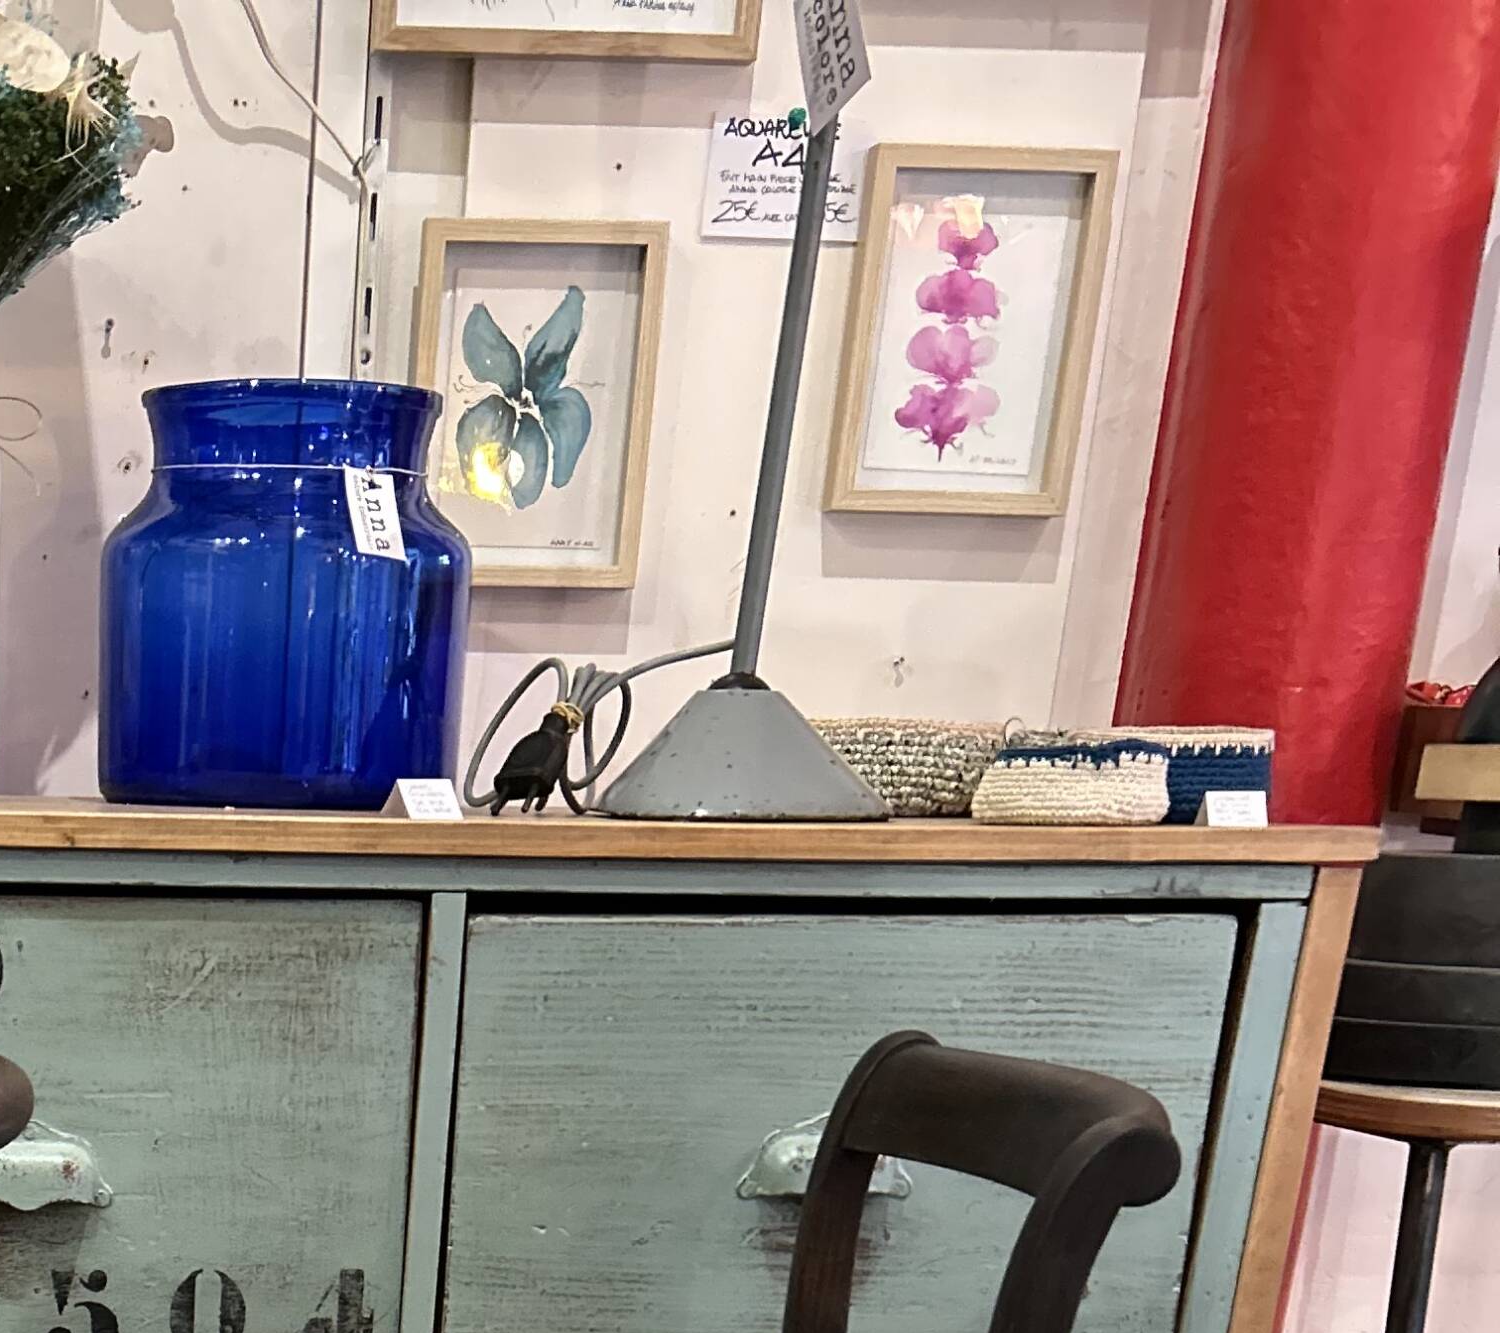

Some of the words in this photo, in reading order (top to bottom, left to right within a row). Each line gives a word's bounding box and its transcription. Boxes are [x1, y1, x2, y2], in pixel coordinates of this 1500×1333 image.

[828, 0, 856, 89] nna
[723, 116, 842, 141] AQUAREL
[751, 138, 806, 175] A4
[711, 199, 761, 224] 25€
[825, 202, 857, 223] 5€
[360, 476, 391, 552] Anna
